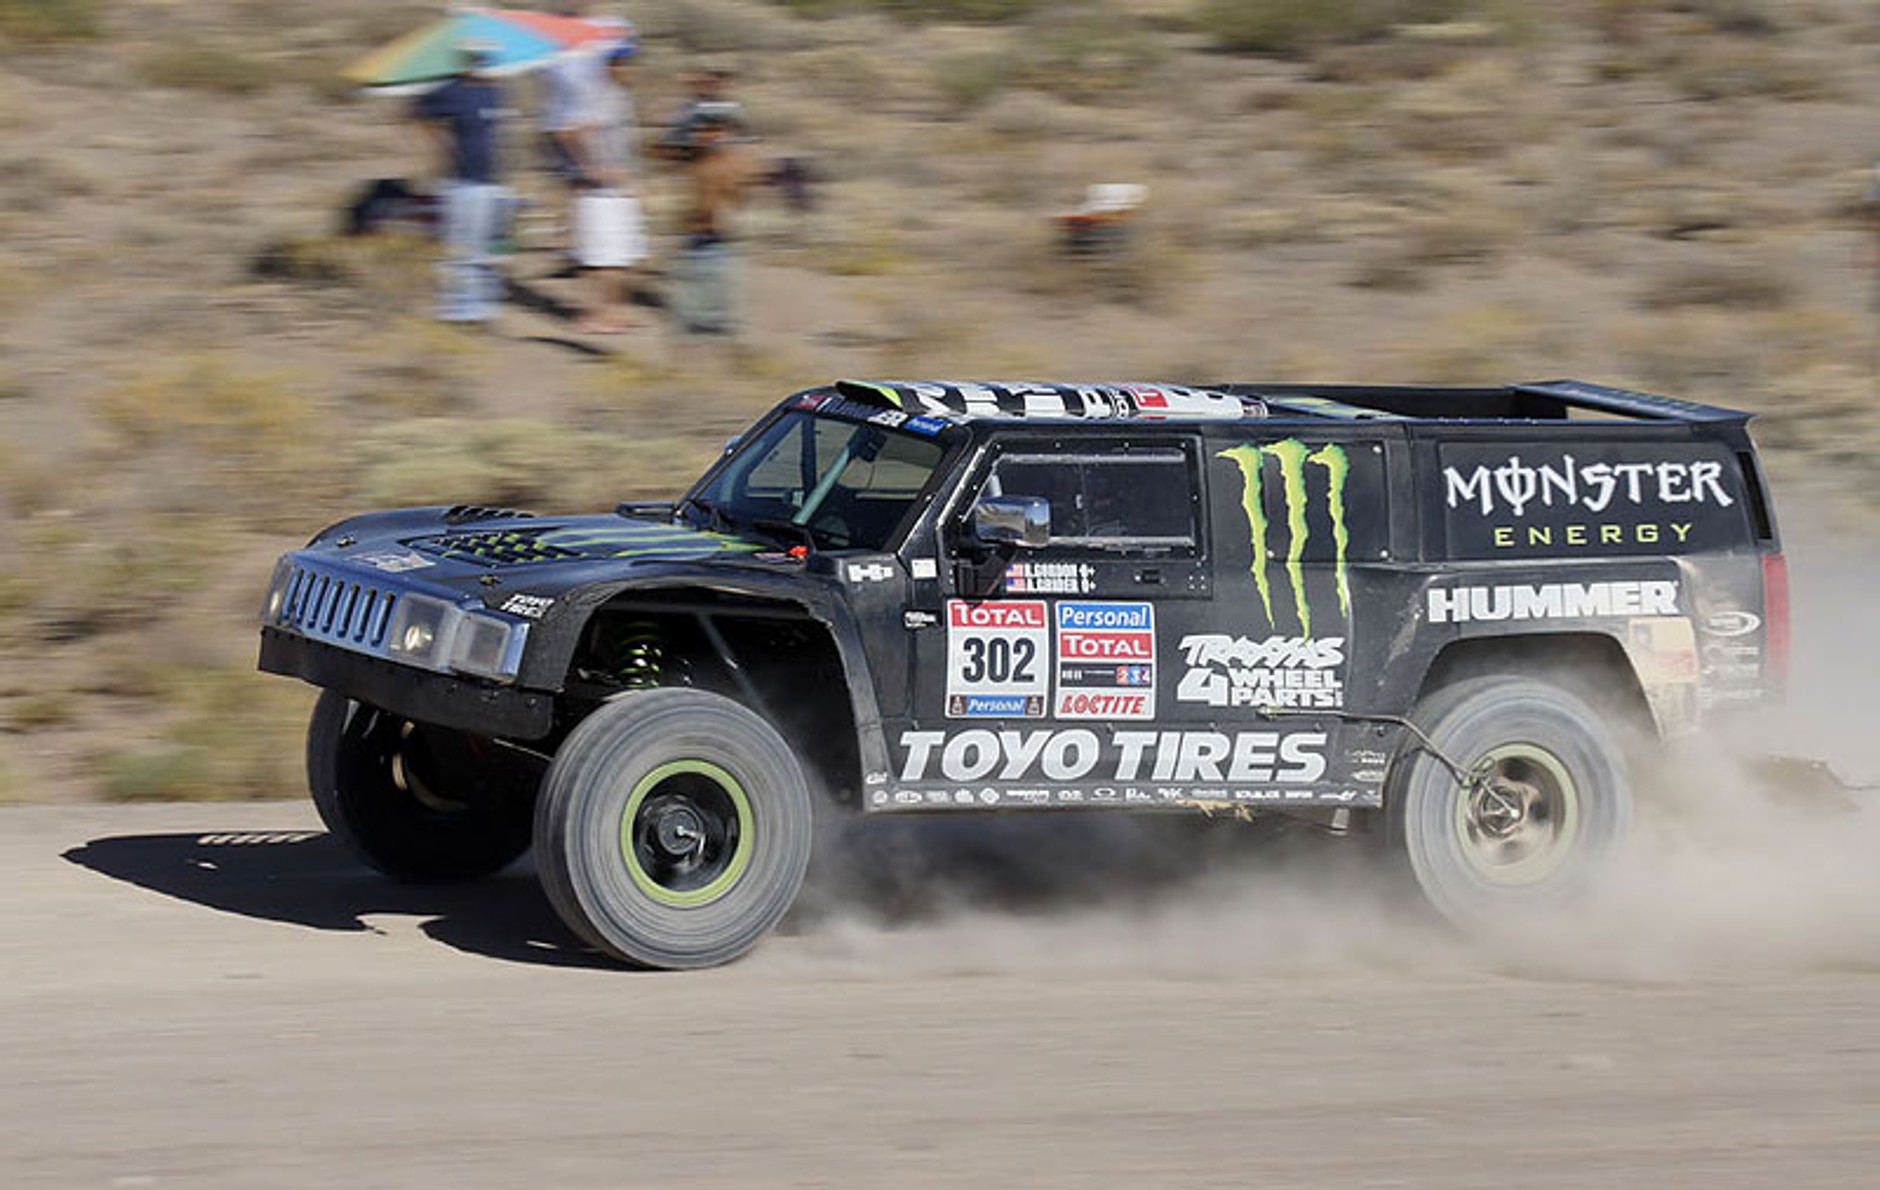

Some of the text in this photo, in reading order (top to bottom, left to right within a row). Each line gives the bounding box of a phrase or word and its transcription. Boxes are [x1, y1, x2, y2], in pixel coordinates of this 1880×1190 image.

[1444, 455, 1733, 516] MONSTER
[1494, 523, 1692, 546] ENERGY
[1428, 581, 1679, 622] HUMMER
[954, 604, 1042, 625] TOTAL
[1062, 606, 1147, 627] Personal
[1062, 635, 1149, 656] TOTAL
[1178, 635, 1345, 669] TRAXXAS
[962, 637, 1036, 683] 302
[1177, 668, 1343, 707] 4 WHEEL
[1231, 687, 1335, 707] PARTS
[968, 698, 1025, 712] Personal
[1060, 694, 1146, 714] LOCTITE
[900, 728, 1328, 783] TOYO TIRES
